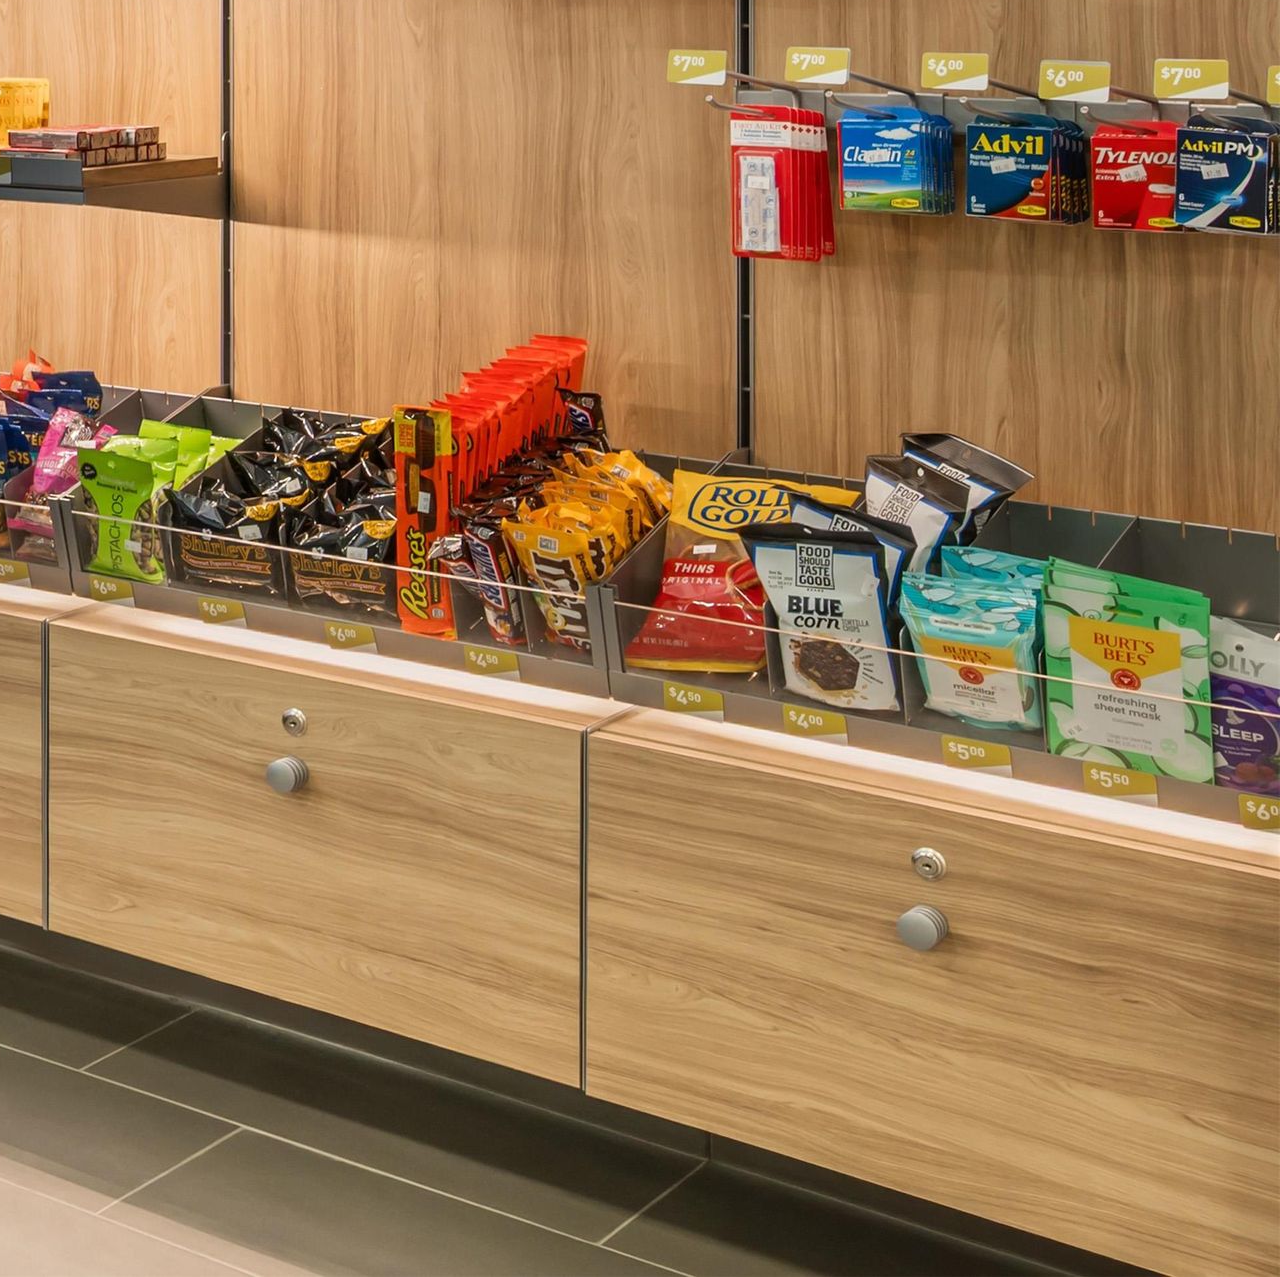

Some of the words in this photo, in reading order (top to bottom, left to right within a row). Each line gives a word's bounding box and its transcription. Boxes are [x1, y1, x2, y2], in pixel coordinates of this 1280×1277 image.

[971, 132, 1044, 156] Advil
[1180, 138, 1223, 155] Advil
[1224, 142, 1254, 157] PM
[799, 546, 831, 558] FOOD
[674, 563, 715, 574] THINS
[799, 556, 831, 568] SHOULD
[799, 566, 830, 577] TASTE
[401, 527, 431, 620] Reese's
[799, 575, 831, 587] GOOD
[788, 595, 843, 617] BLUE
[794, 617, 840, 630] corn
[1093, 631, 1155, 655] BURT'S
[1103, 646, 1147, 667] BEES
[1094, 701, 1126, 715] sheet
[1129, 709, 1161, 722] mask
[1097, 692, 1157, 713] refreshing
[1212, 724, 1264, 743] SLEEP
